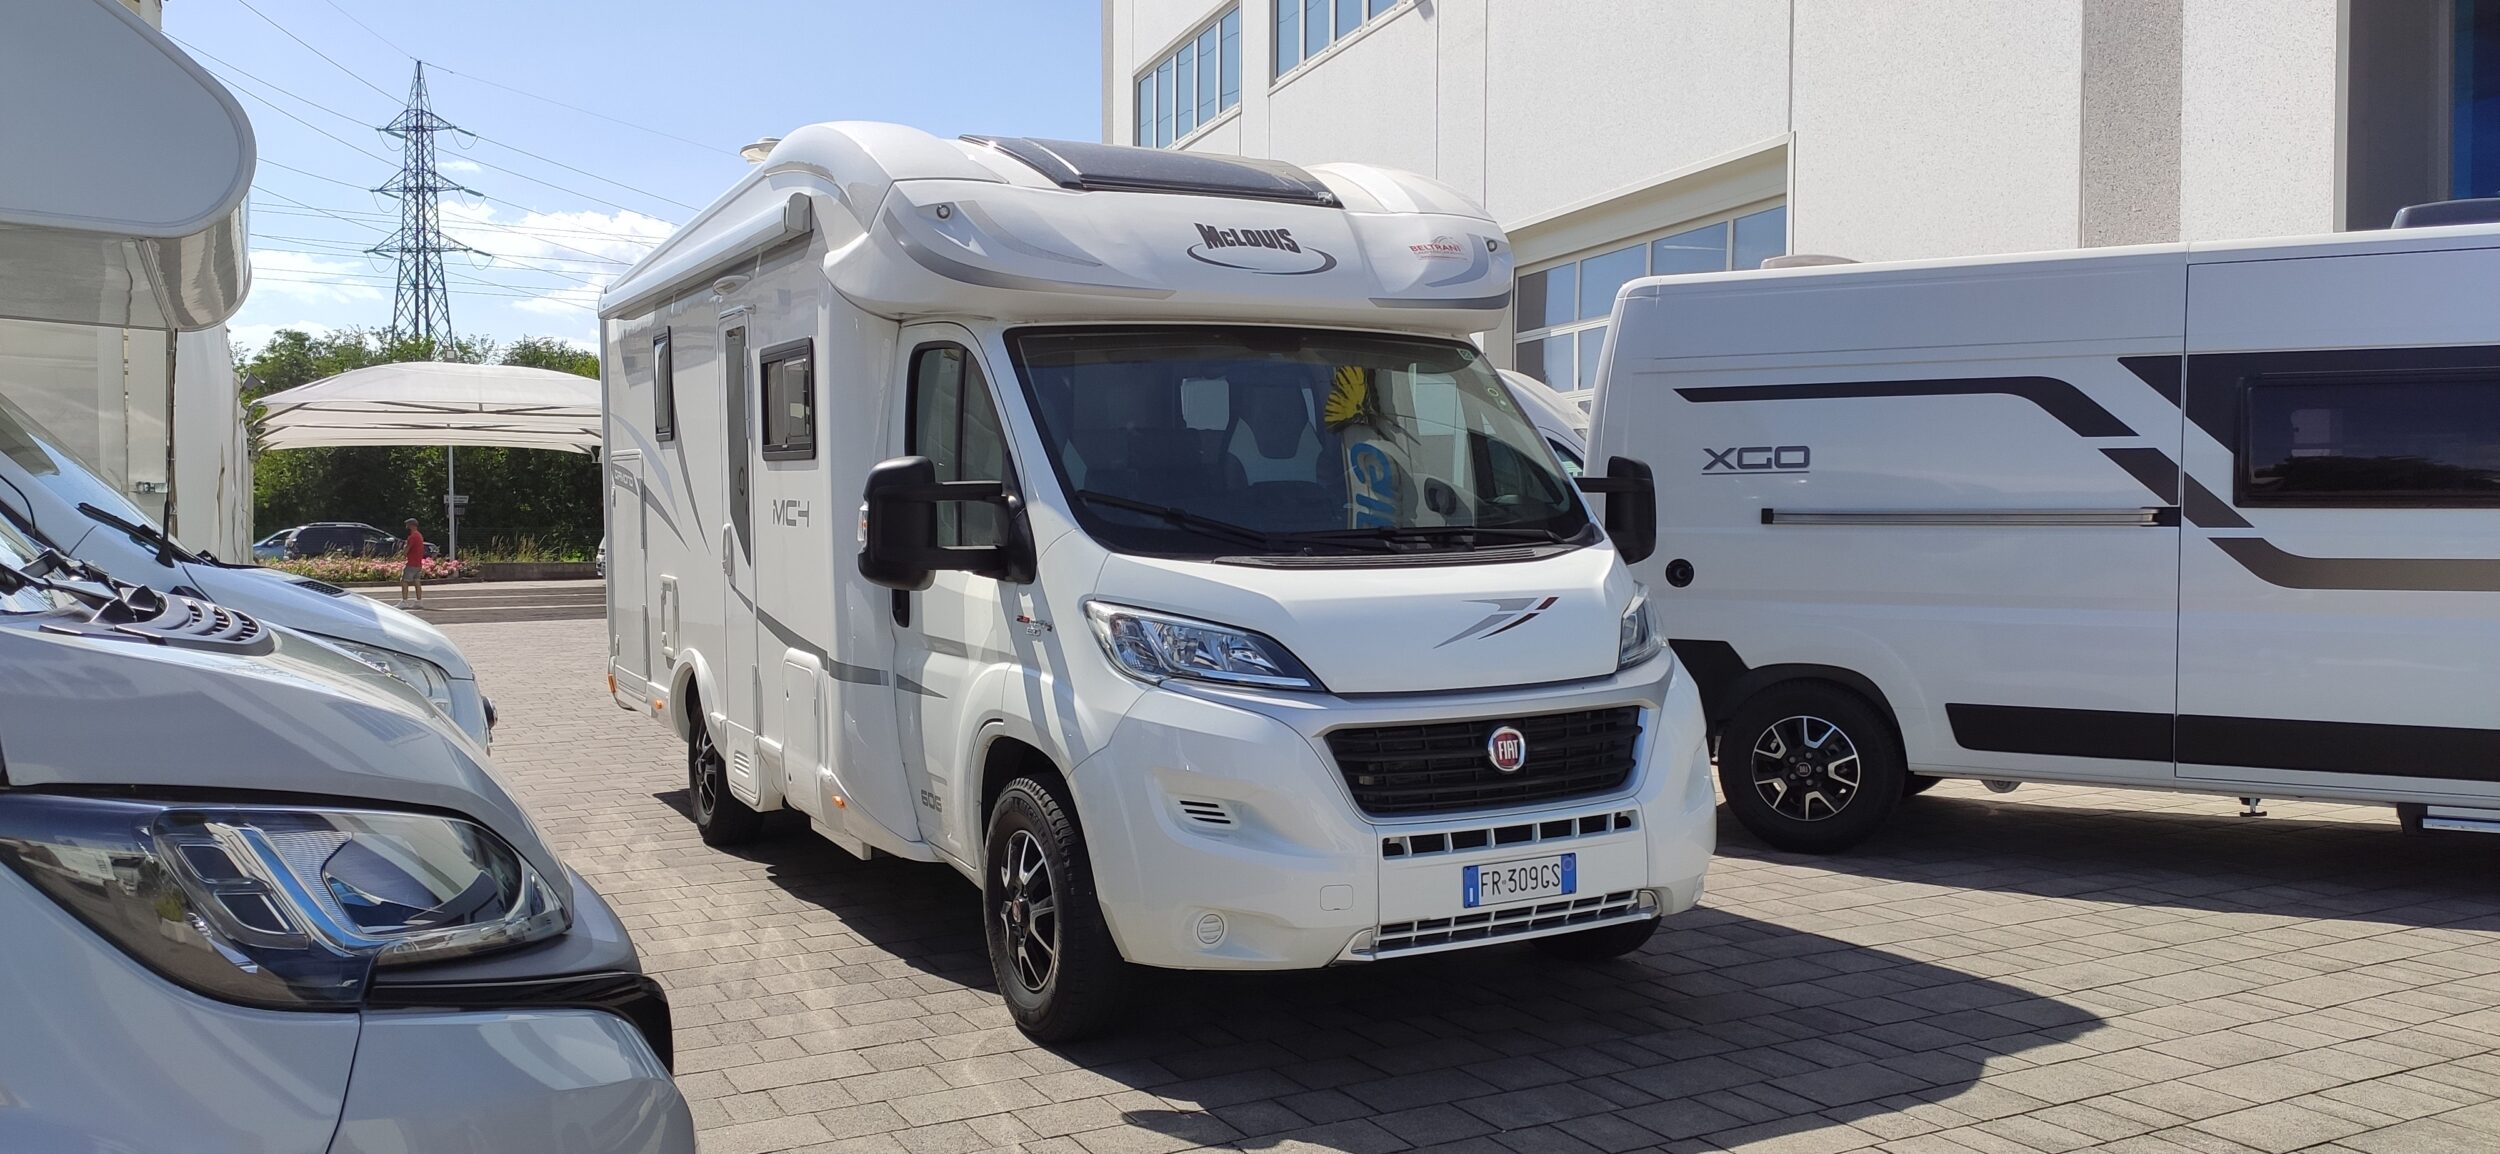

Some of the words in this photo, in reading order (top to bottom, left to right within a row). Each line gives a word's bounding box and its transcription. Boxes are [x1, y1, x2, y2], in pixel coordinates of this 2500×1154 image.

[1193, 222, 1302, 254] McLOUIS
[1409, 243, 1462, 253] BELTRANI
[1702, 445, 1810, 470] XGO
[1497, 739, 1518, 760] FIAT
